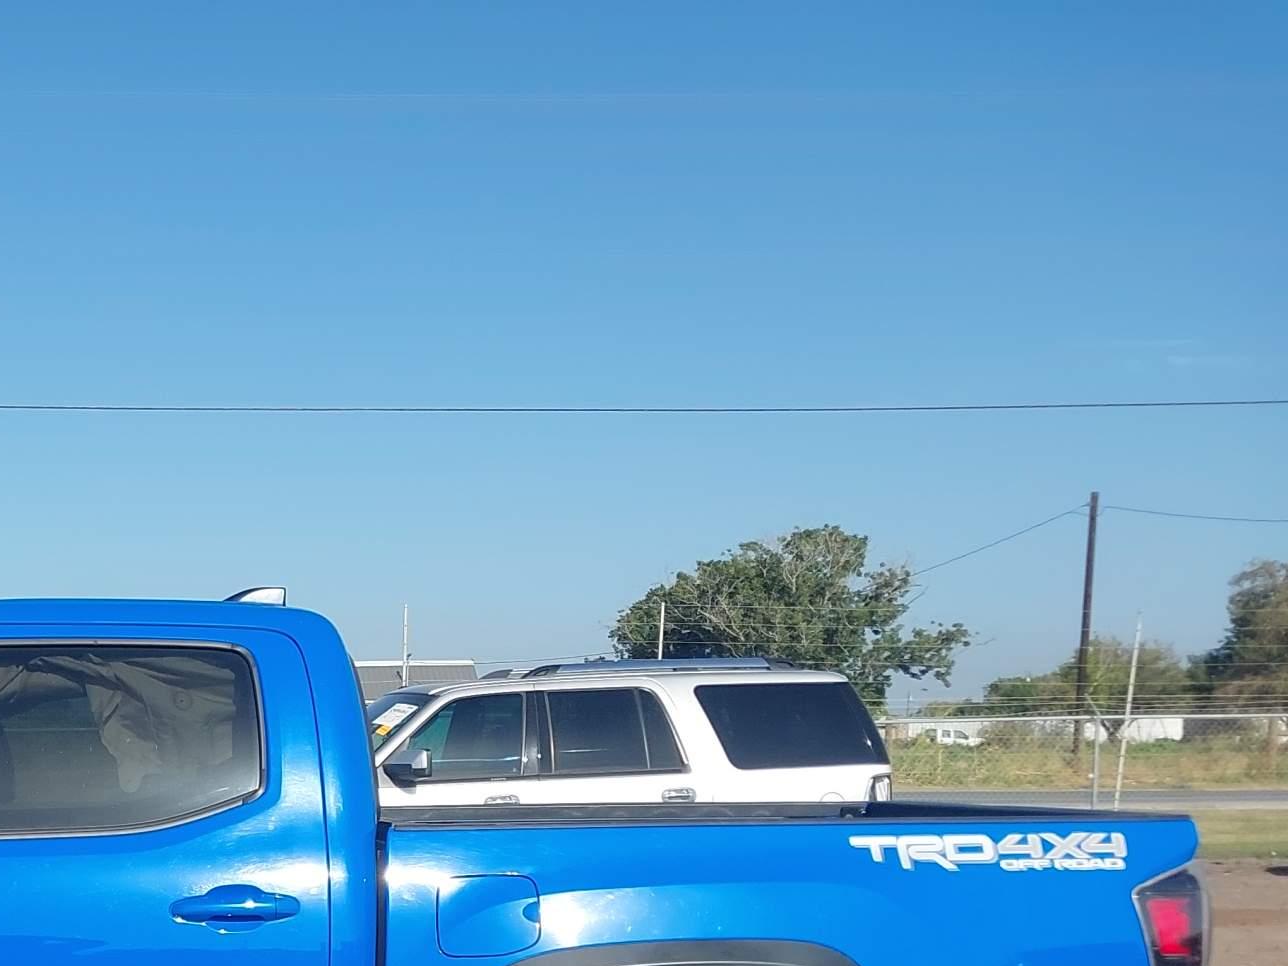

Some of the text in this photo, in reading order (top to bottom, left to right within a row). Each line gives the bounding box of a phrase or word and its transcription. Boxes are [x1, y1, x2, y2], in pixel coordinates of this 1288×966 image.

[848, 833, 999, 872] TRD
[999, 858, 1127, 871] OFF ROAD
